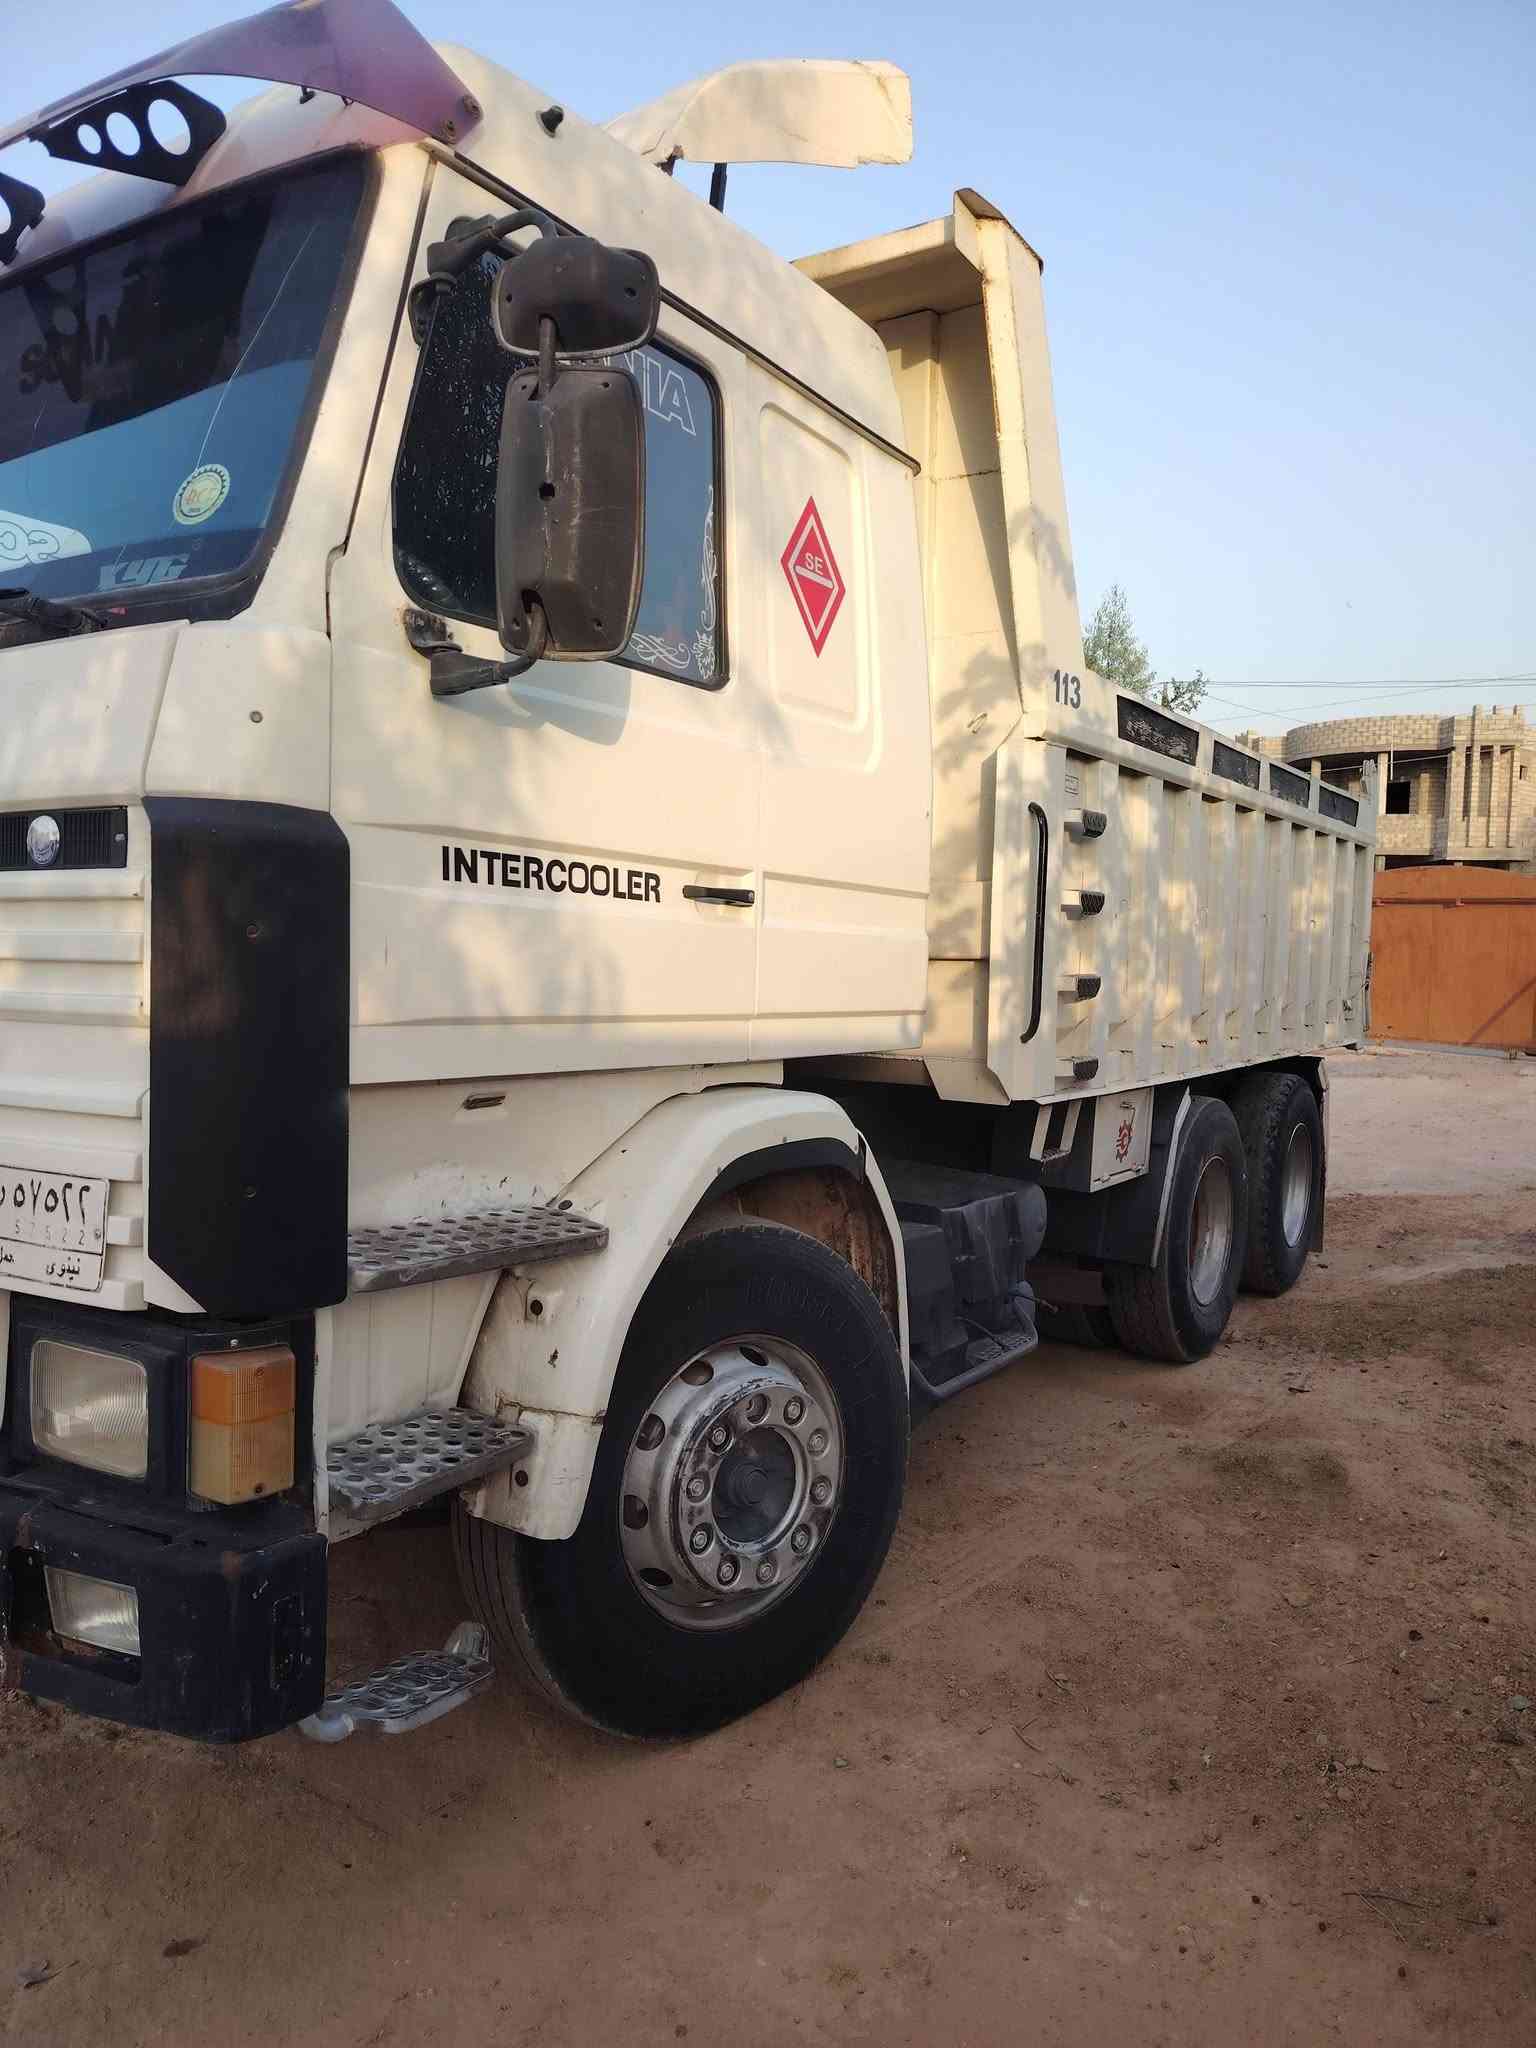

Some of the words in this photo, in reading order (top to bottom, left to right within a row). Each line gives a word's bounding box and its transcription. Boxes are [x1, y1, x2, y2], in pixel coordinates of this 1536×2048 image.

[804, 552, 823, 576] SE
[1054, 669, 1080, 709] 113
[441, 845, 661, 903] INTERCOOLER
